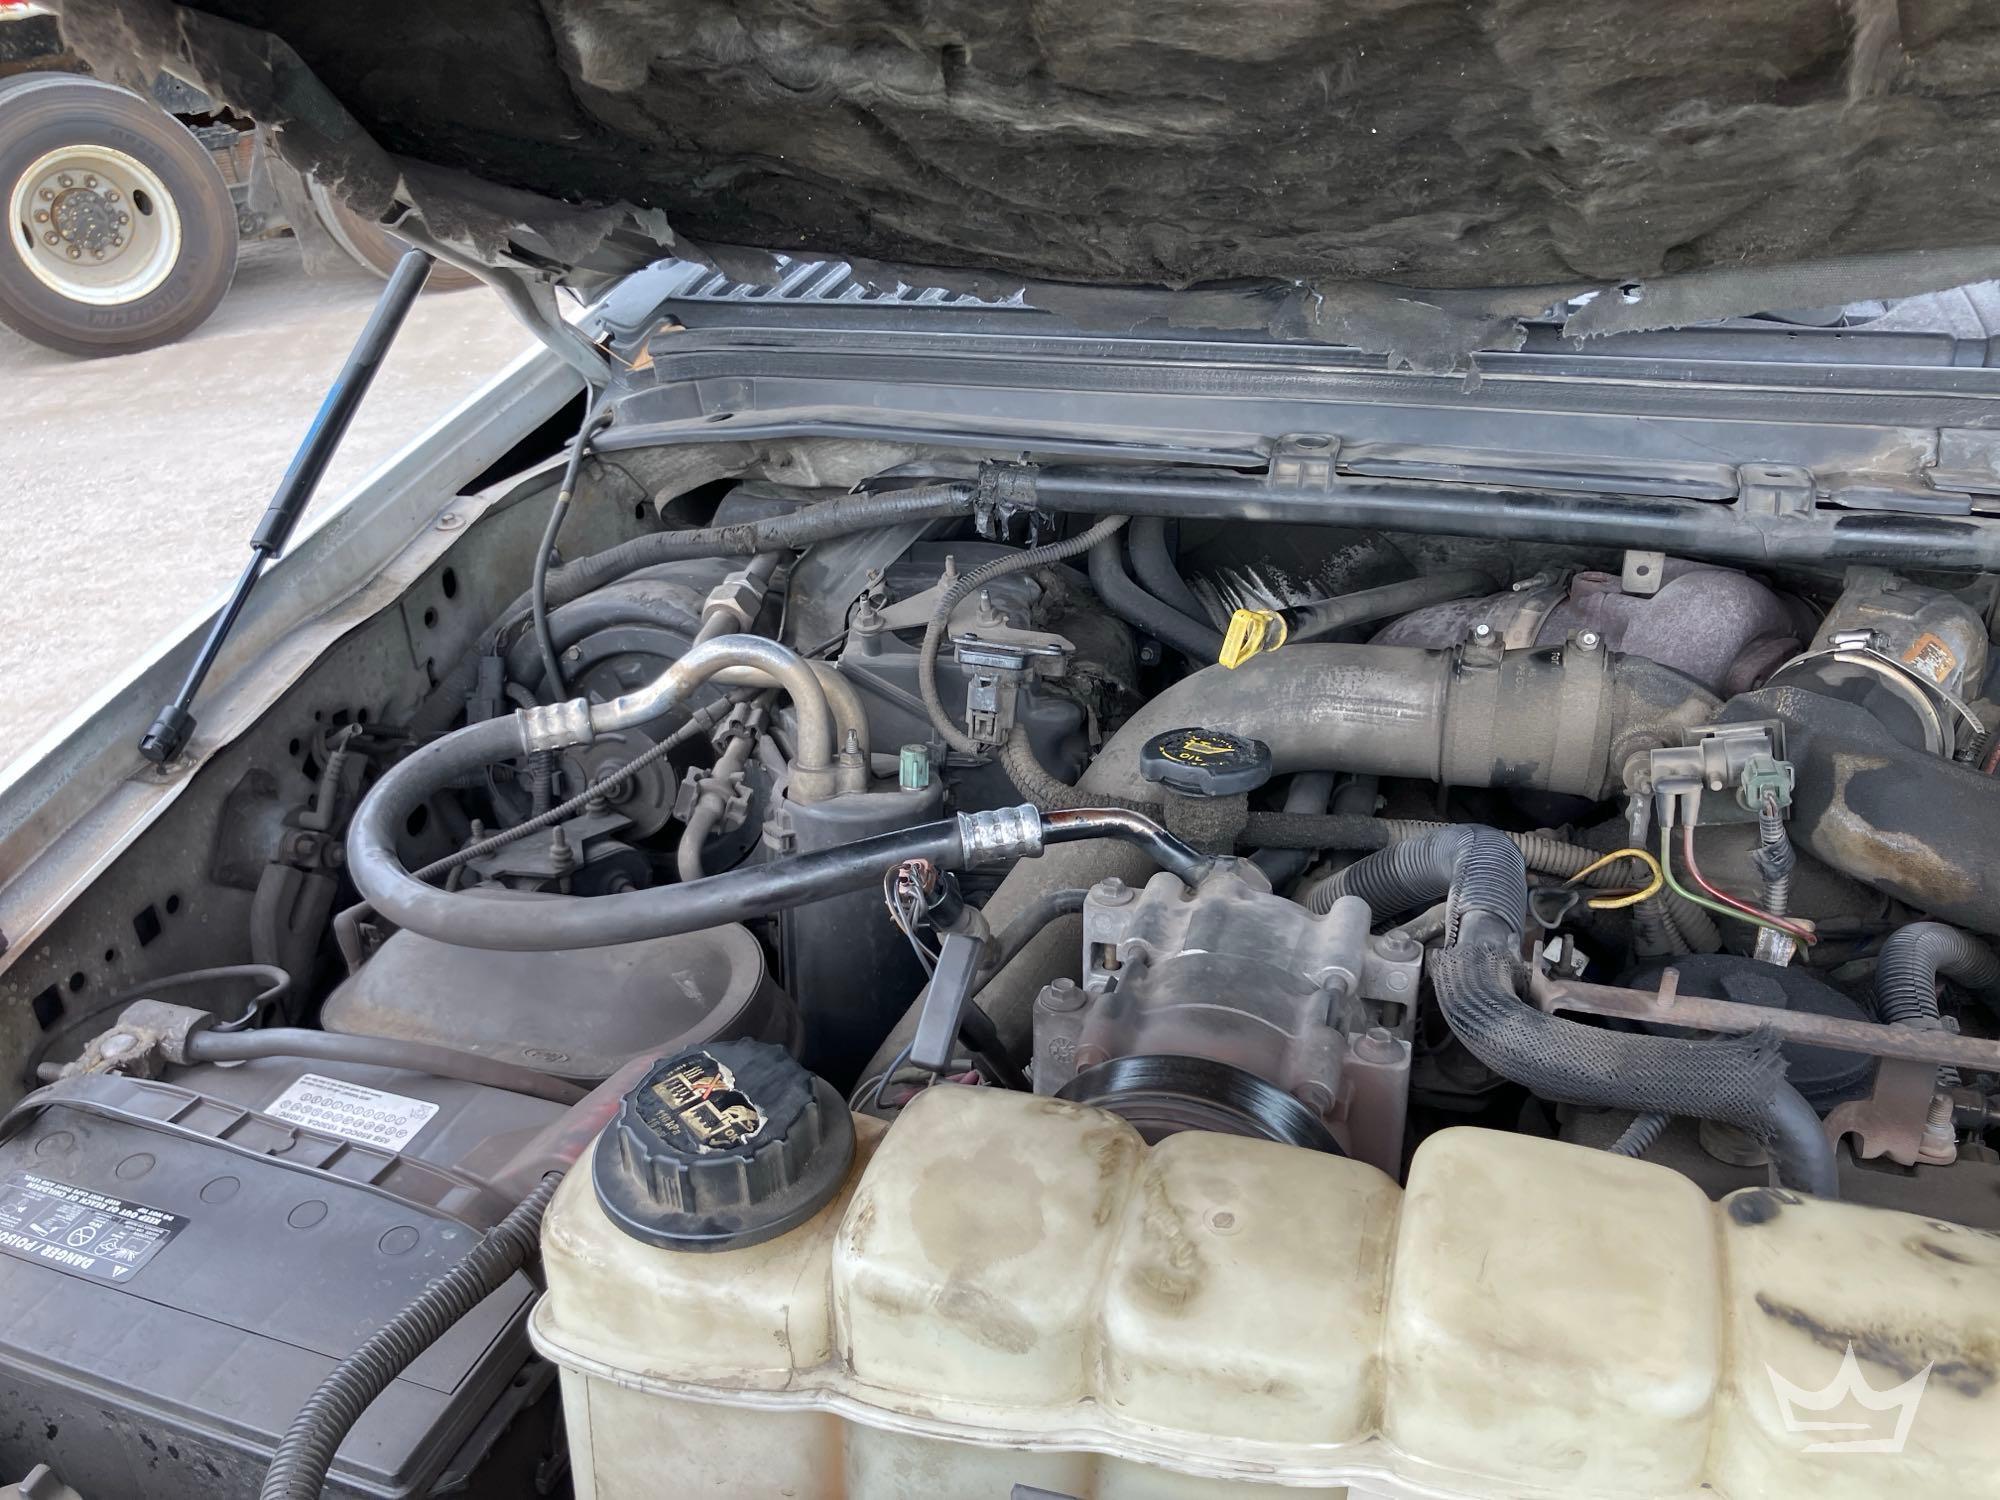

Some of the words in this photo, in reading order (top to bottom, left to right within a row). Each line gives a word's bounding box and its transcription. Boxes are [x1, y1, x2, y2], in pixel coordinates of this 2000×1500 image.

[1179, 752, 1203, 762] OIL
[25, 1182, 67, 1198] CHILDREN
[65, 1193, 80, 1202] OF
[79, 1197, 108, 1210] REACH
[105, 1205, 120, 1213] OF
[118, 1208, 139, 1218] OUT
[138, 1215, 162, 1225] KEEP
